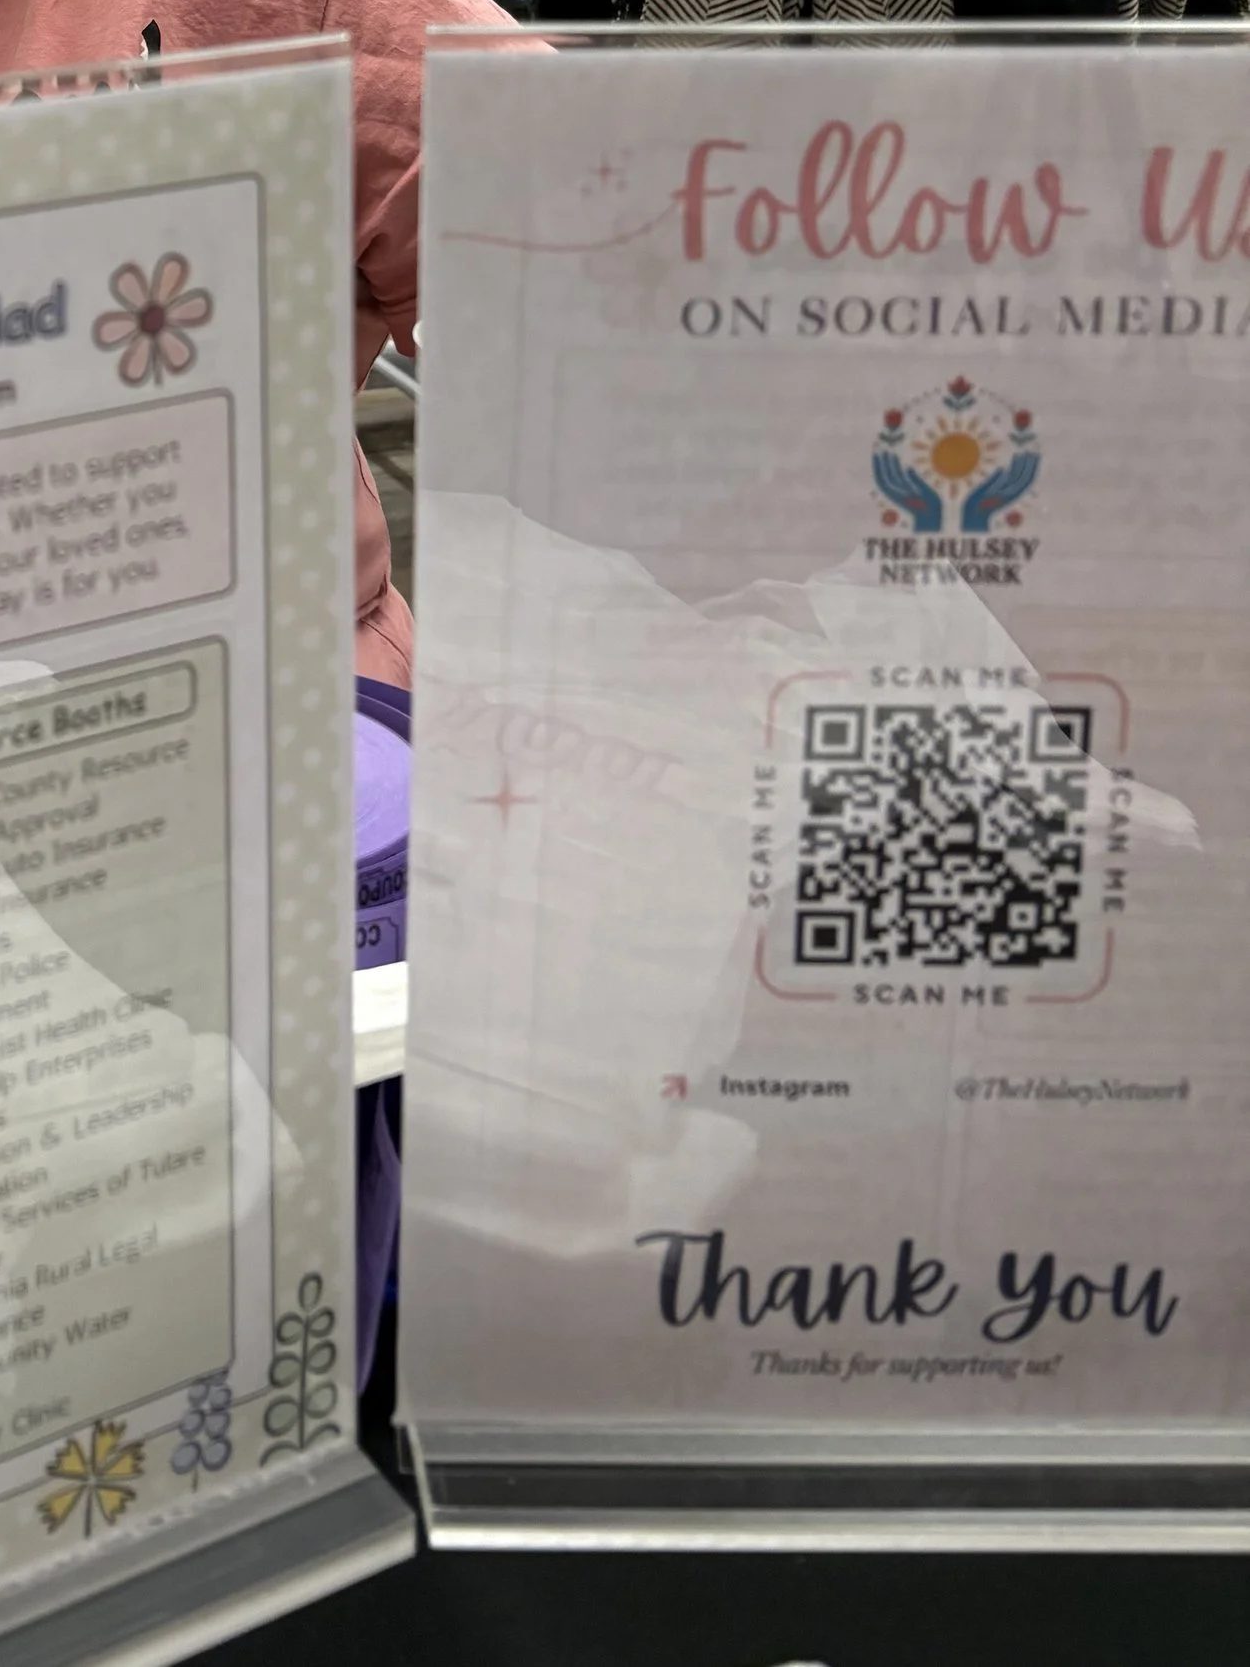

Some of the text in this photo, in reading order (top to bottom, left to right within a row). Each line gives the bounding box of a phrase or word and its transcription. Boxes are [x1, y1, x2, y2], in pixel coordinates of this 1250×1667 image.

[672, 120, 1250, 263] Follow U
[681, 295, 772, 338] ON
[796, 295, 1031, 337] SOCIAL
[863, 538, 1040, 562] THE HULSEY
[879, 562, 1022, 586] NETWORK
[870, 666, 1029, 689] SCAN ME
[751, 764, 777, 907] SCAN ME
[1103, 865, 1125, 913] ME
[854, 984, 1010, 1005] SCAN ME
[720, 1074, 850, 1101] Instagram
[636, 1230, 958, 1330] Thank
[752, 1351, 842, 1376] Thanks
[844, 1351, 883, 1381] for
[888, 1352, 1021, 1381] supporting
